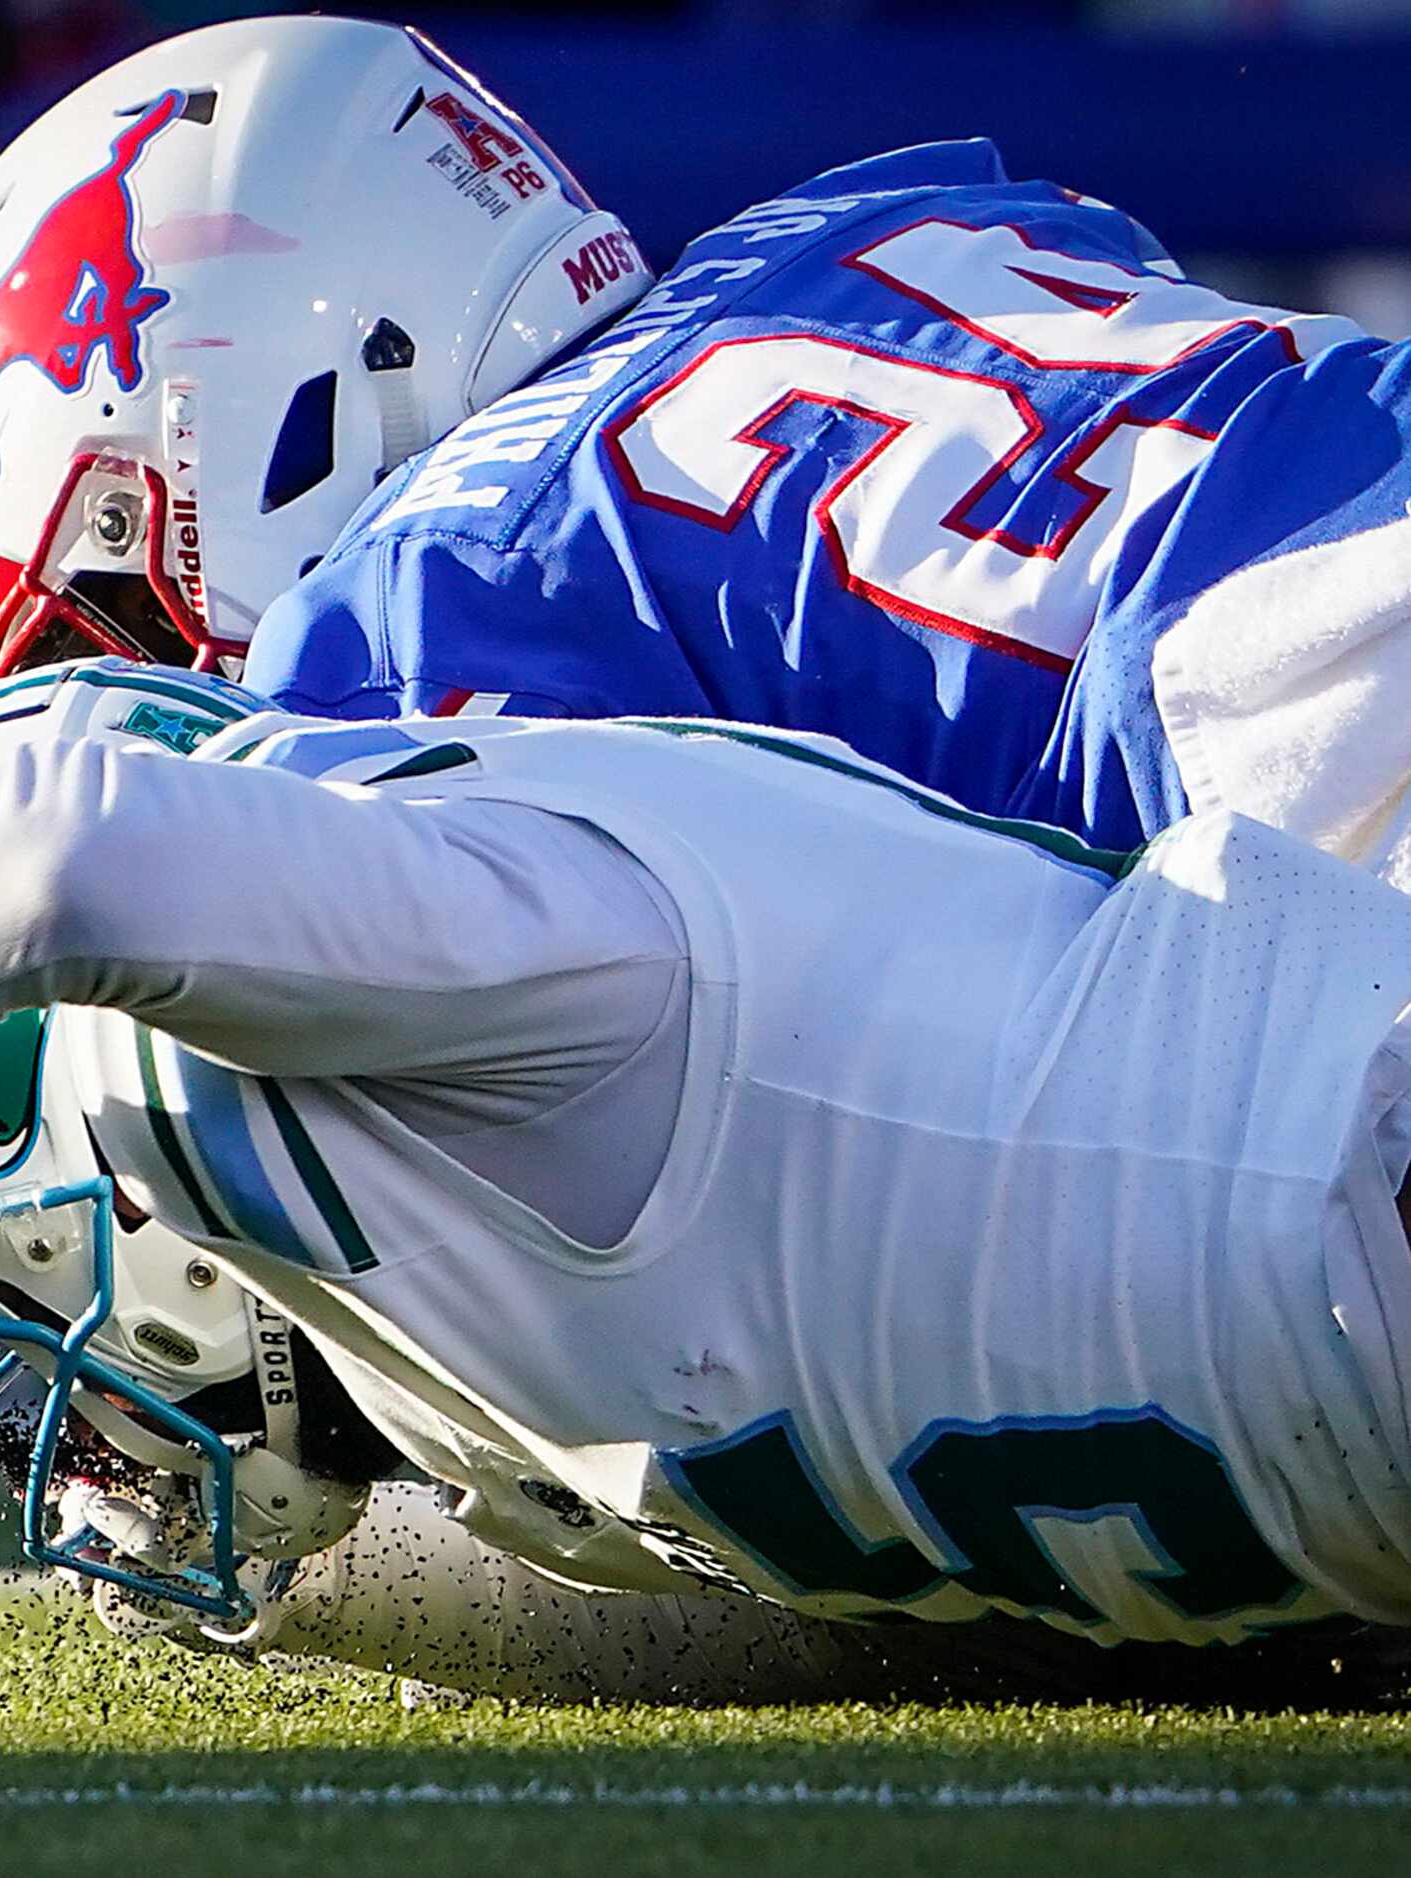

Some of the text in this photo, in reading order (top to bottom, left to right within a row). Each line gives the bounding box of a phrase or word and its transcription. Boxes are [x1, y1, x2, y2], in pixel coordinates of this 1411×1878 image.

[603, 216, 1375, 676] 24
[173, 500, 209, 630] iddell
[256, 1297, 294, 1406] SPORT
